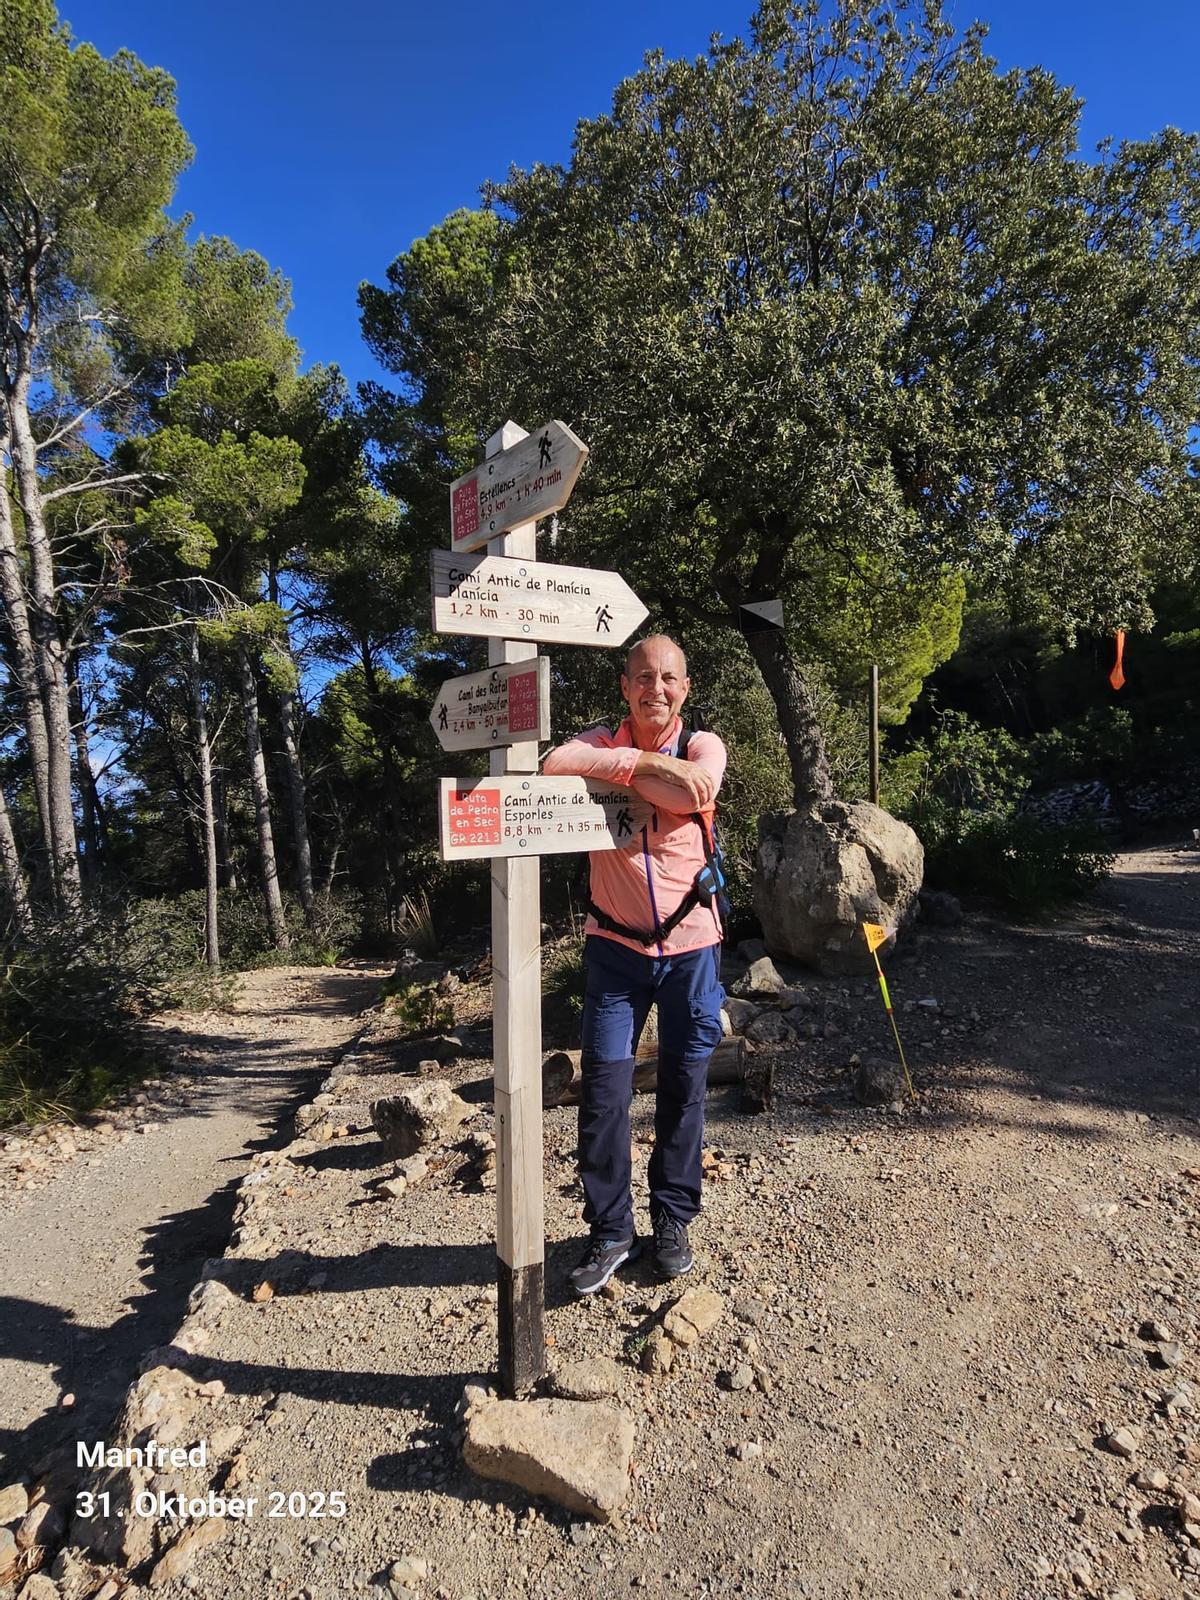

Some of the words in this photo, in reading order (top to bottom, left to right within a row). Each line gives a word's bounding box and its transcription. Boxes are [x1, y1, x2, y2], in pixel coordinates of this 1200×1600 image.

[480, 478, 516, 505] Estellencs
[495, 500, 506, 512] km
[517, 489, 522, 502] 1
[525, 483, 530, 497] h
[532, 477, 544, 493] 40
[546, 468, 562, 487] min
[449, 568, 480, 583] Camí
[487, 574, 520, 588] Antic
[526, 577, 541, 590] de
[547, 579, 591, 596] Planícia
[449, 585, 499, 602] Planícia
[450, 602, 473, 618] 1,2
[479, 604, 498, 619] km
[518, 608, 534, 621] 30
[539, 612, 560, 624] min
[458, 685, 473, 701] Camí
[475, 685, 487, 698] des
[466, 718, 476, 730] km
[484, 714, 494, 728] 50
[496, 715, 508, 726] min
[463, 792, 487, 804] Ruta
[504, 793, 532, 807] Camí
[537, 793, 567, 806] Antic
[571, 793, 585, 805] de
[589, 791, 629, 806] Planícia
[450, 806, 464, 816] de
[468, 804, 499, 815] Pedra
[505, 808, 553, 823] Esporles
[456, 819, 470, 828] en
[474, 816, 494, 828] Sec
[504, 825, 523, 838] 8,8
[527, 824, 542, 835] km
[557, 823, 564, 833] 2
[568, 822, 574, 833] h
[578, 821, 590, 832] 35
[594, 822, 611, 832] min
[450, 833, 467, 845] GR
